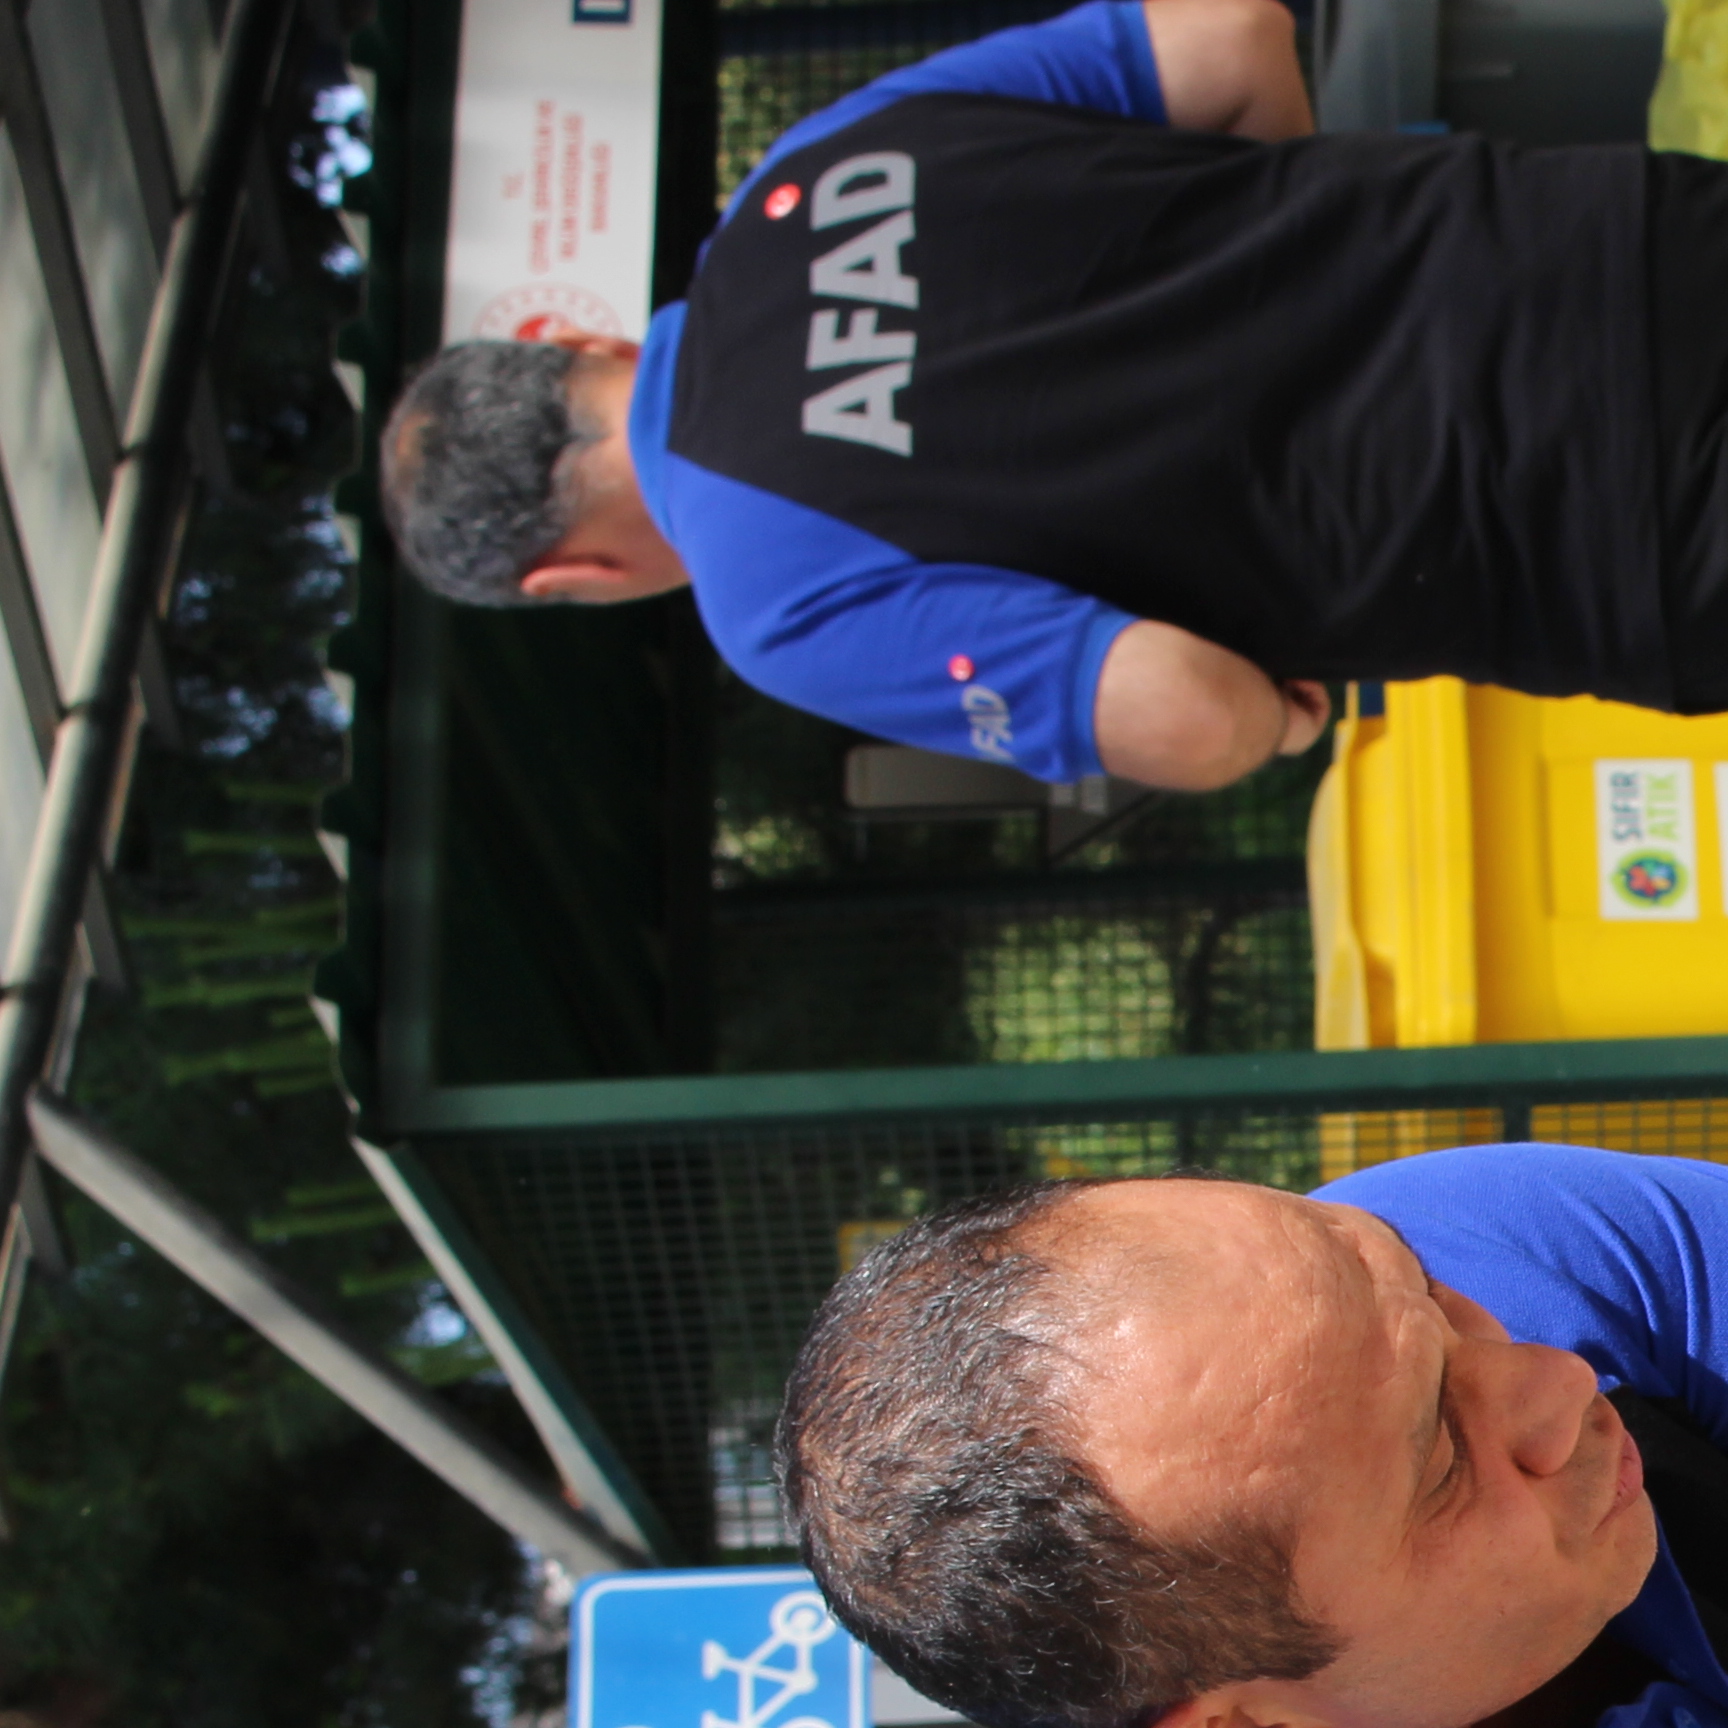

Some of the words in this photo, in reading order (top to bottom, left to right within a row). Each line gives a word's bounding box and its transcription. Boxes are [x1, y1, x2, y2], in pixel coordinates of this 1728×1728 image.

[800, 151, 919, 457] AFAD
[1609, 772, 1642, 842] SIFIR
[1646, 773, 1677, 841] ATIK
